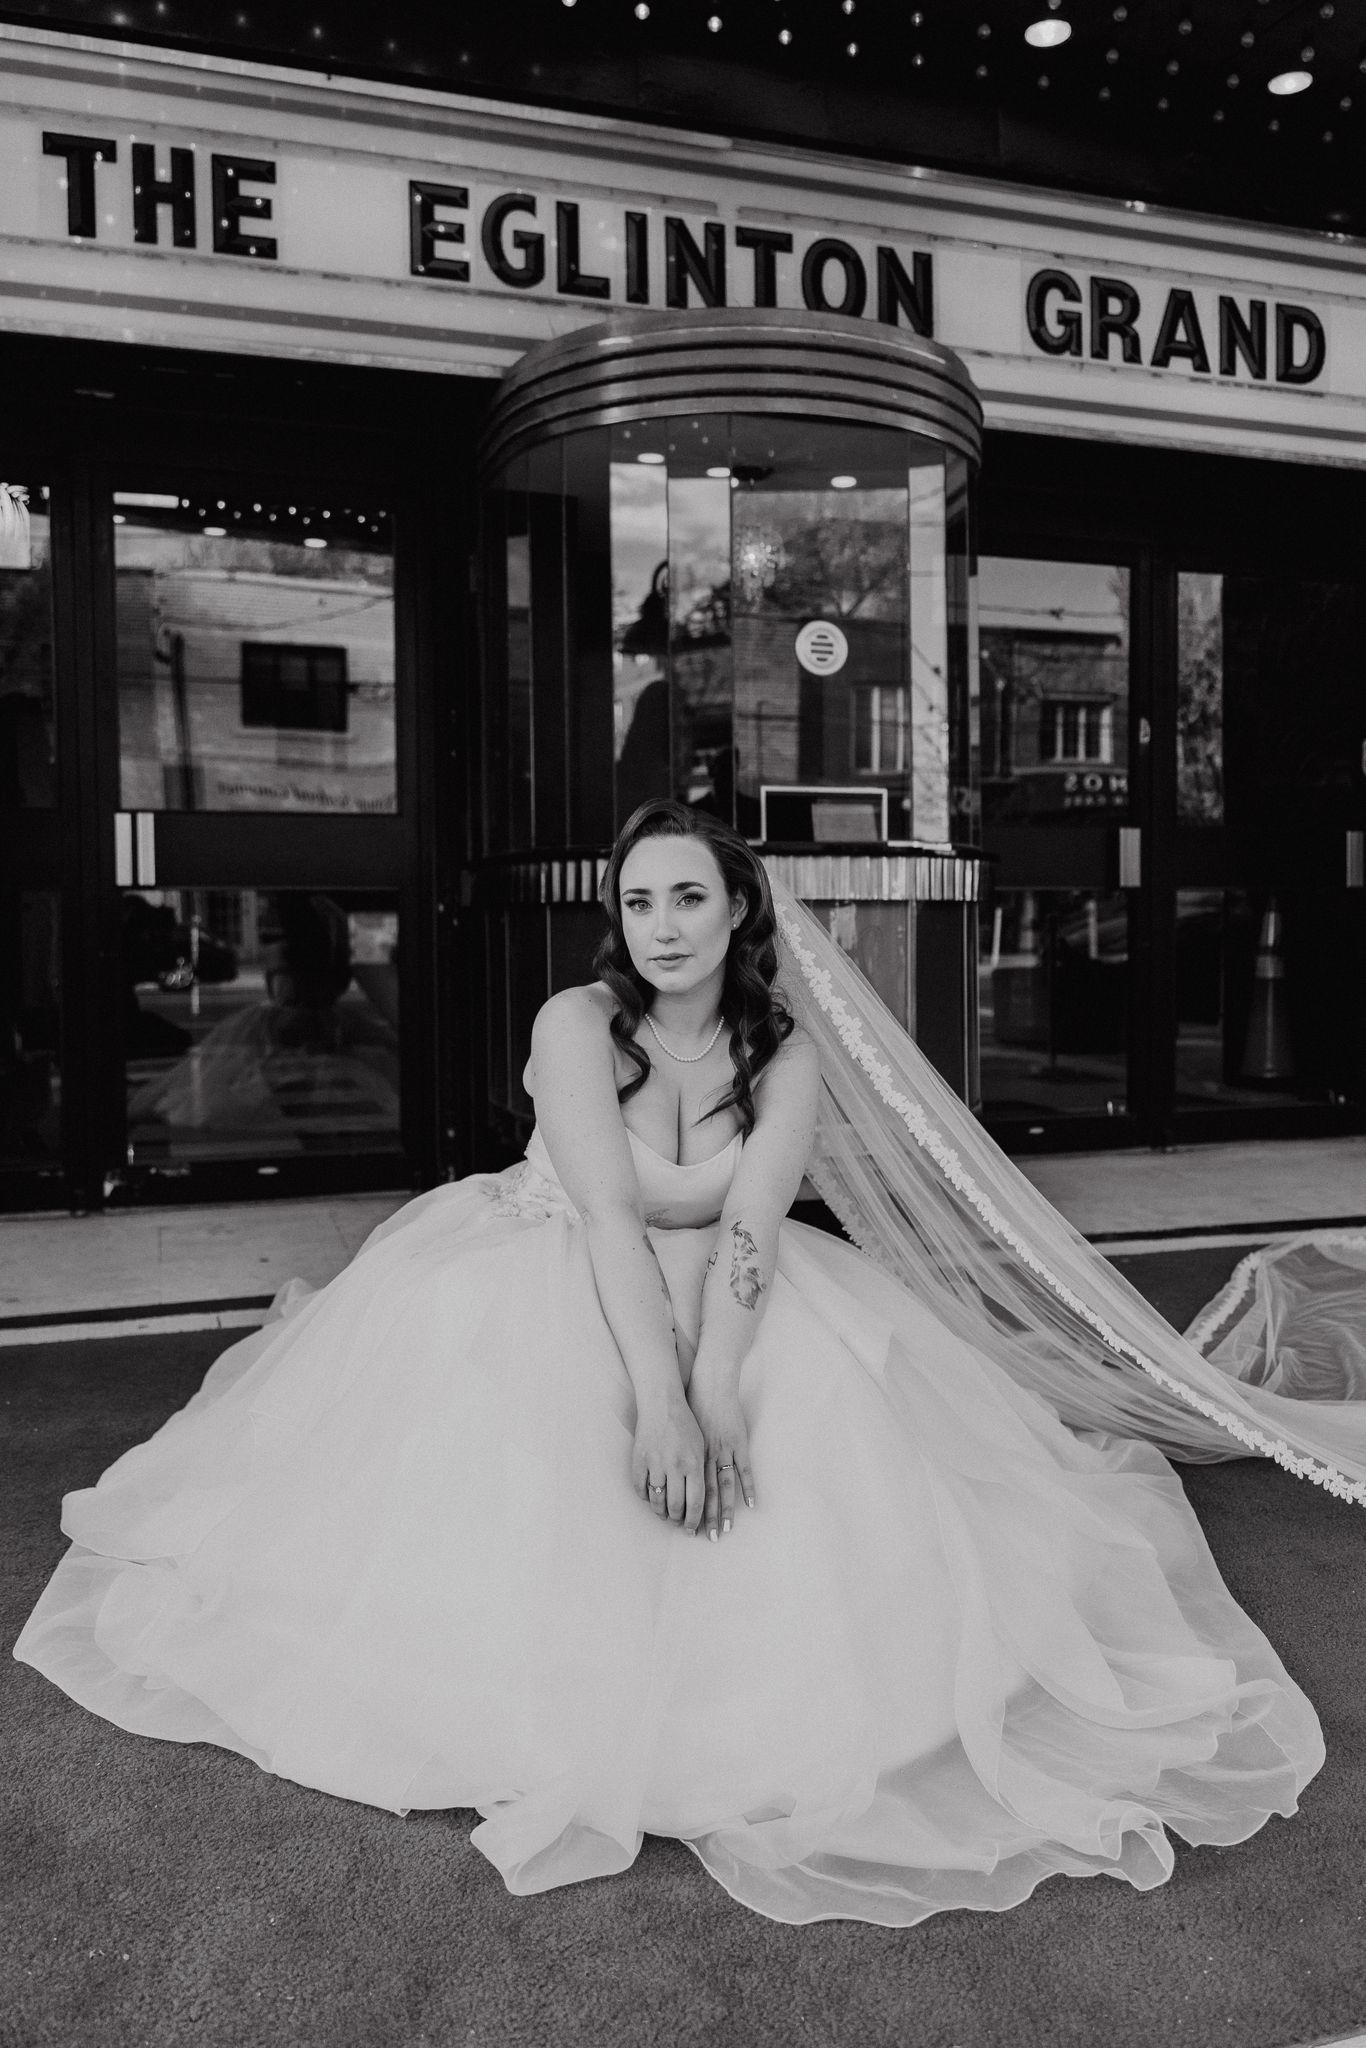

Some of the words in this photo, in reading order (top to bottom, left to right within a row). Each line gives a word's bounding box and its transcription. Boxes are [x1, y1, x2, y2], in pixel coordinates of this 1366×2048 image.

[43, 131, 277, 259] THE
[409, 180, 933, 338] EGLINTON
[1026, 268, 1326, 384] GRAND
